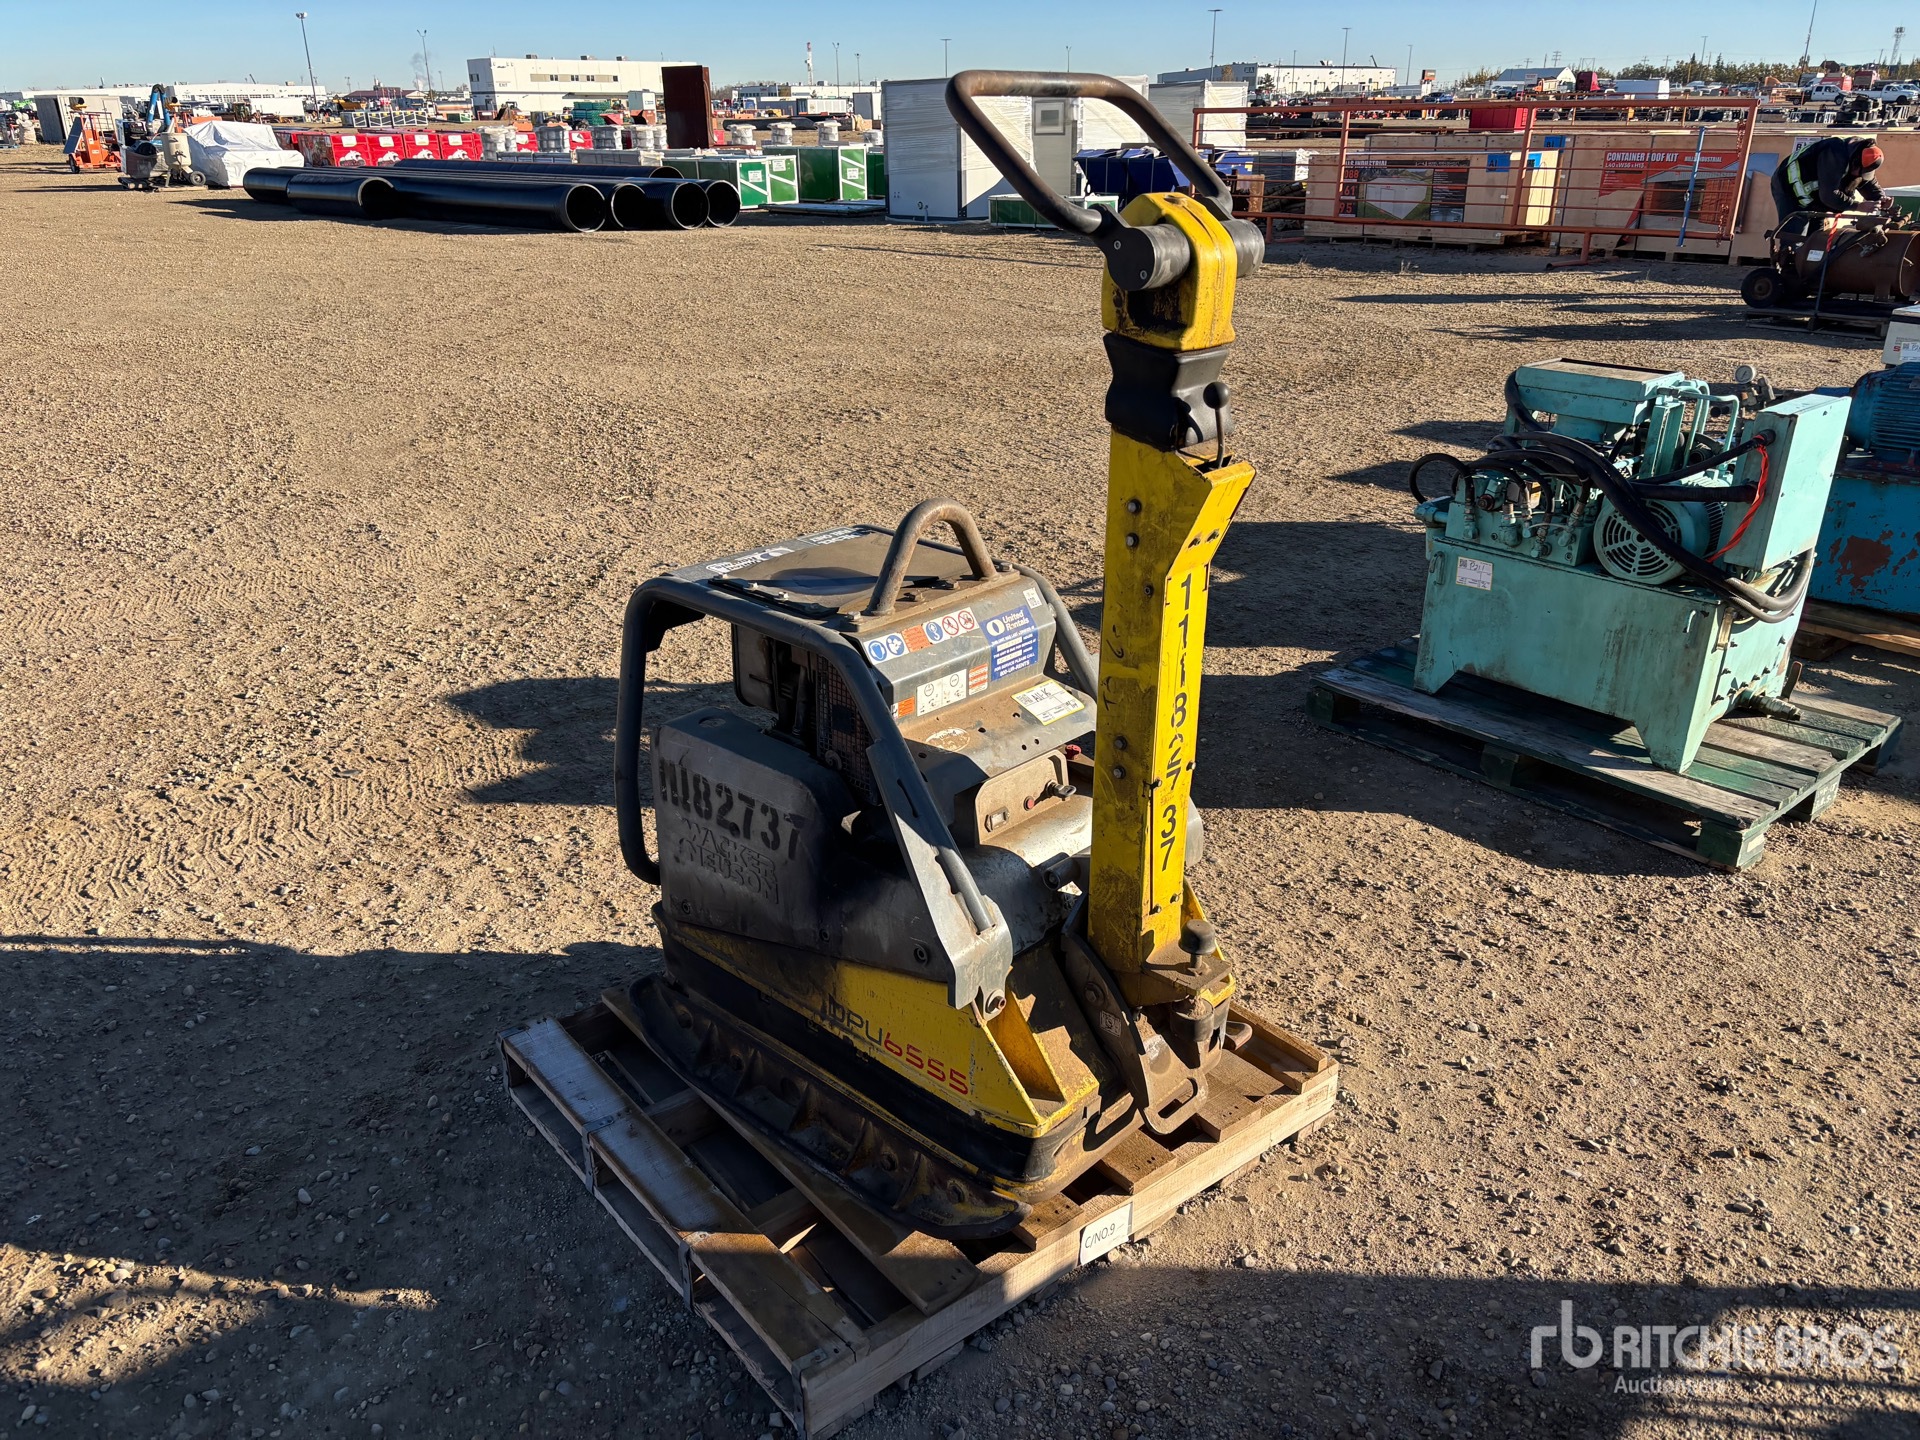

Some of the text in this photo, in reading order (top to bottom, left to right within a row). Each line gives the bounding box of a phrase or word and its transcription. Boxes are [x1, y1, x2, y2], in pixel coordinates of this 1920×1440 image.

[1606, 152, 1645, 162] CONTAINER
[1666, 153, 1679, 162] KIT
[1002, 610, 1024, 624] United
[1005, 617, 1030, 632] Rentals
[1084, 1222, 1116, 1249] C/NO.9
